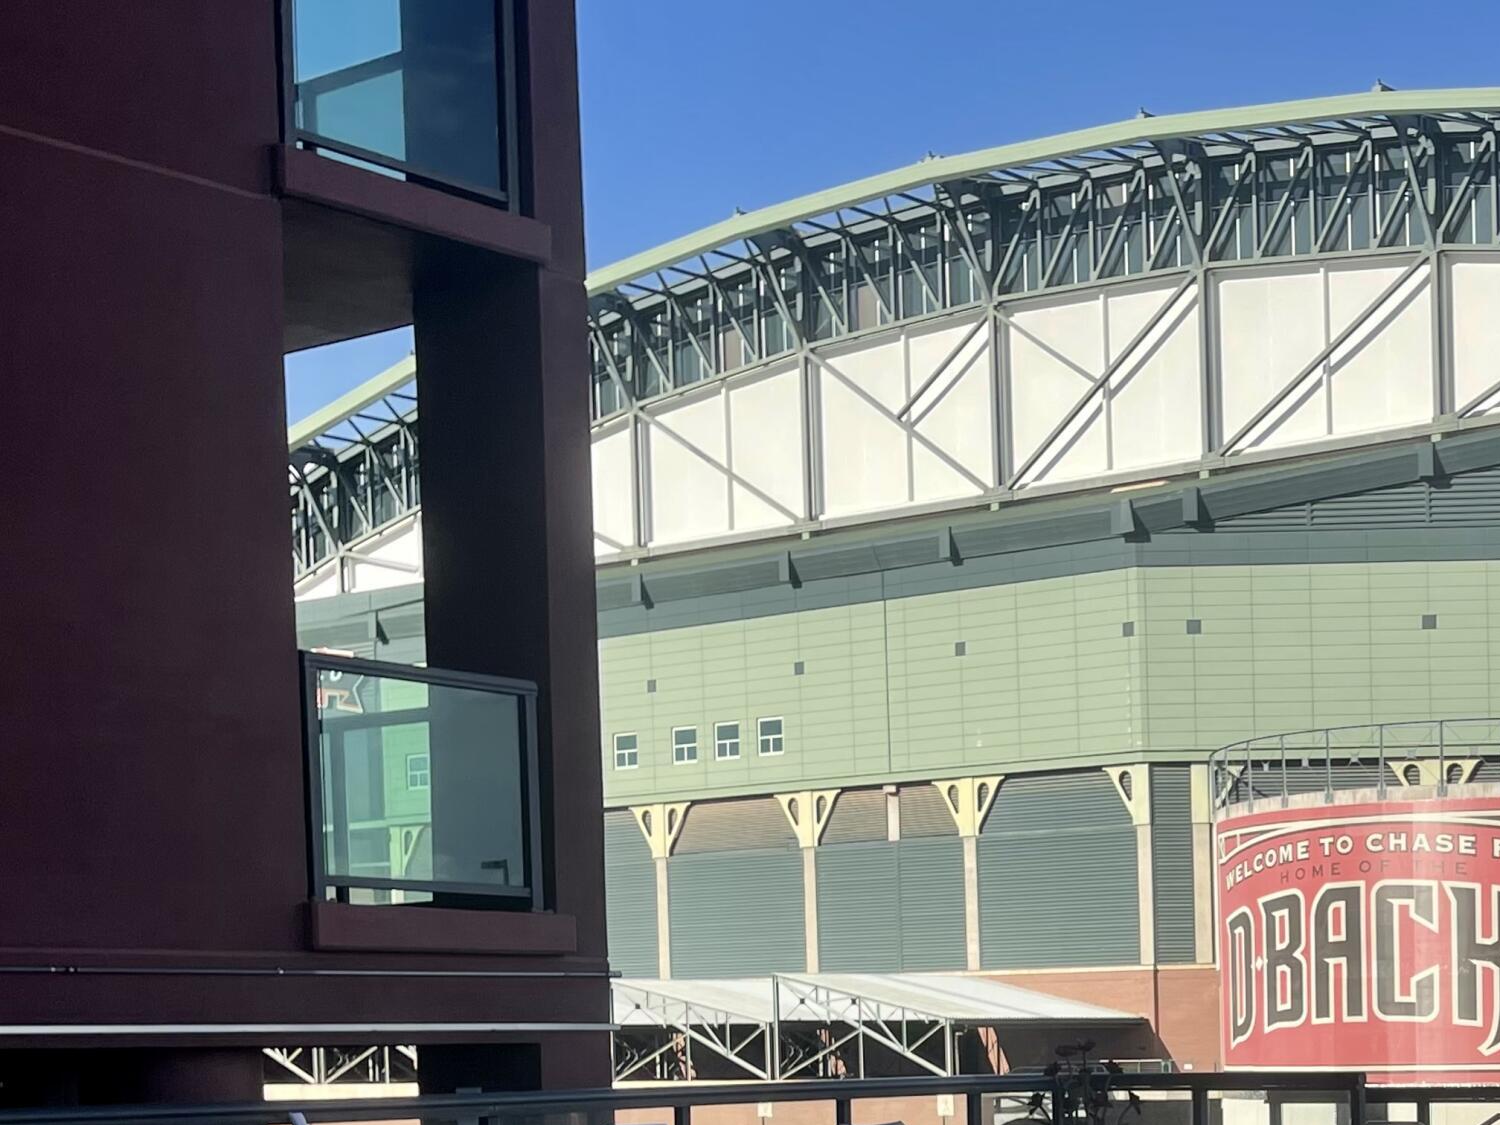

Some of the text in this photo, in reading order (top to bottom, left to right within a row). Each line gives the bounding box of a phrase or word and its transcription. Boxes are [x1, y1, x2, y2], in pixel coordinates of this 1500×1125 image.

[1225, 838, 1310, 892] WELCOME
[1319, 833, 1354, 857] TO
[1364, 832, 1477, 856] CHASE
[1279, 861, 1342, 884] HOME
[1358, 859, 1392, 874] OF
